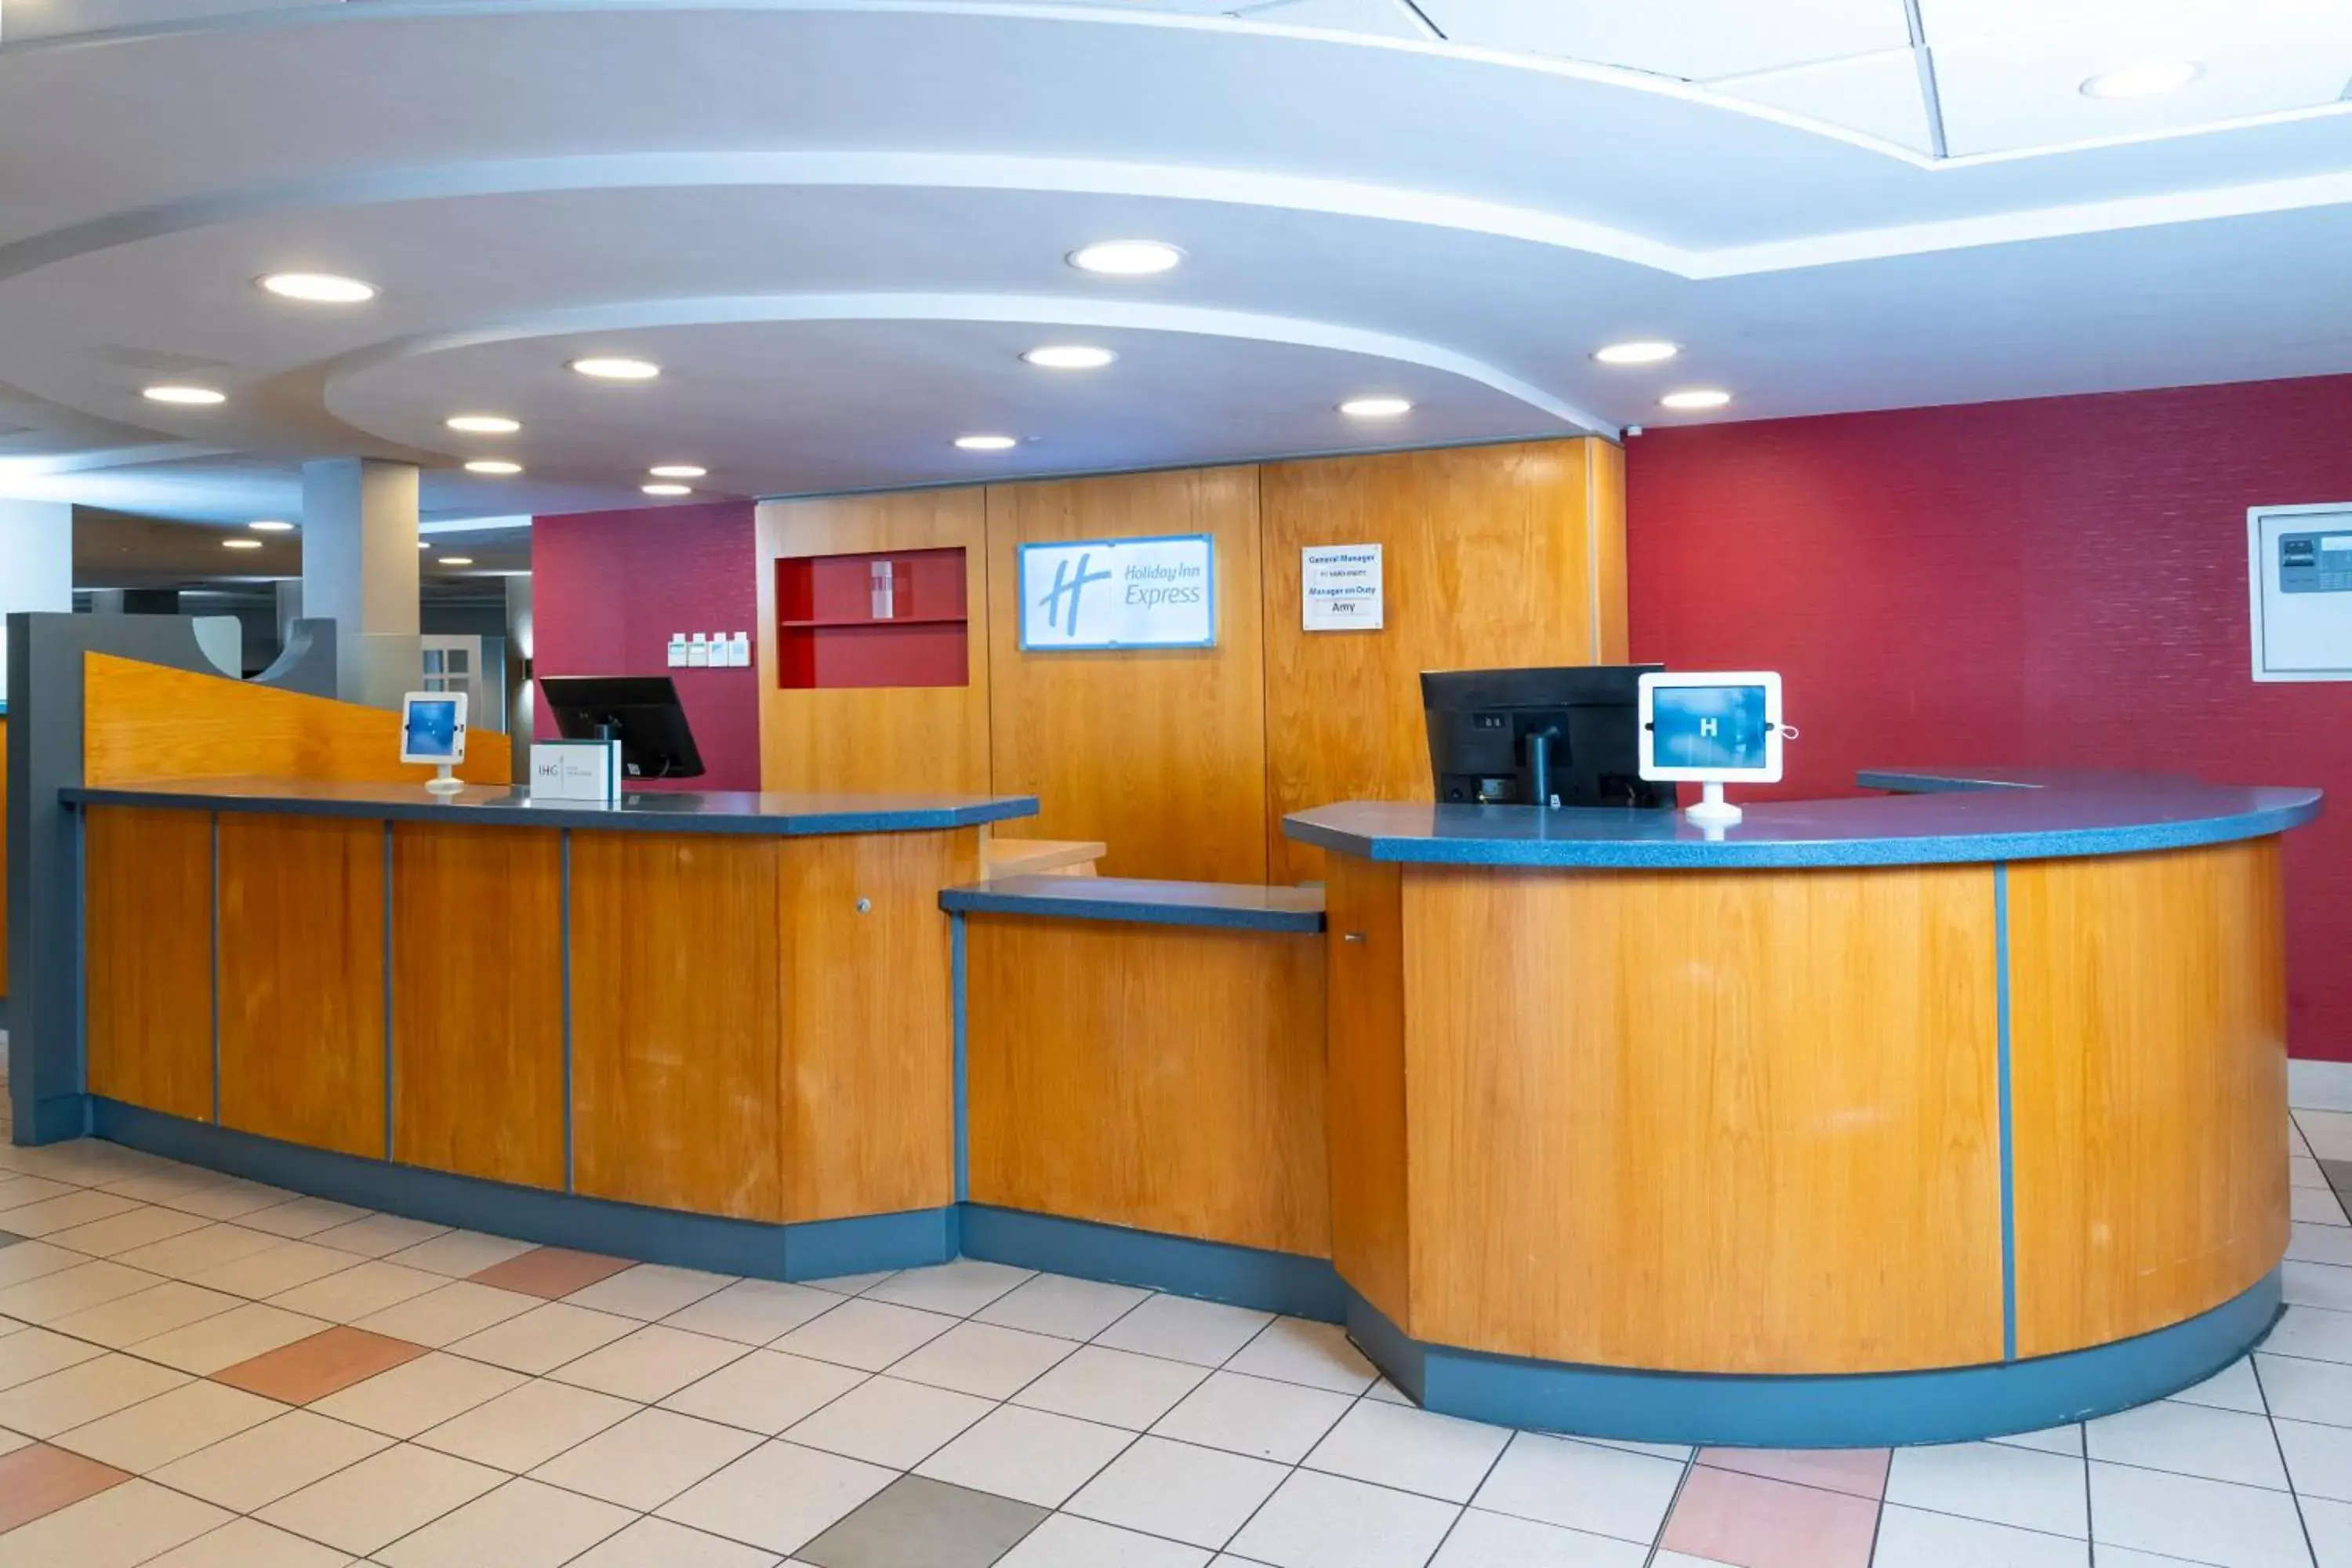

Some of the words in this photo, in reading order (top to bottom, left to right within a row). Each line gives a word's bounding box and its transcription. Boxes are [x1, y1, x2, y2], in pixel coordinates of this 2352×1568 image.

[1340, 554, 1375, 564] Manager
[1124, 564, 1177, 582] Holiday
[1178, 562, 1201, 578] Inn
[1124, 584, 1201, 610] Express
[1308, 587, 1343, 597] Manager
[1356, 586, 1376, 595] Duty
[1332, 602, 1356, 612] Amy
[1700, 717, 1718, 737] H
[539, 764, 559, 777] IHG
